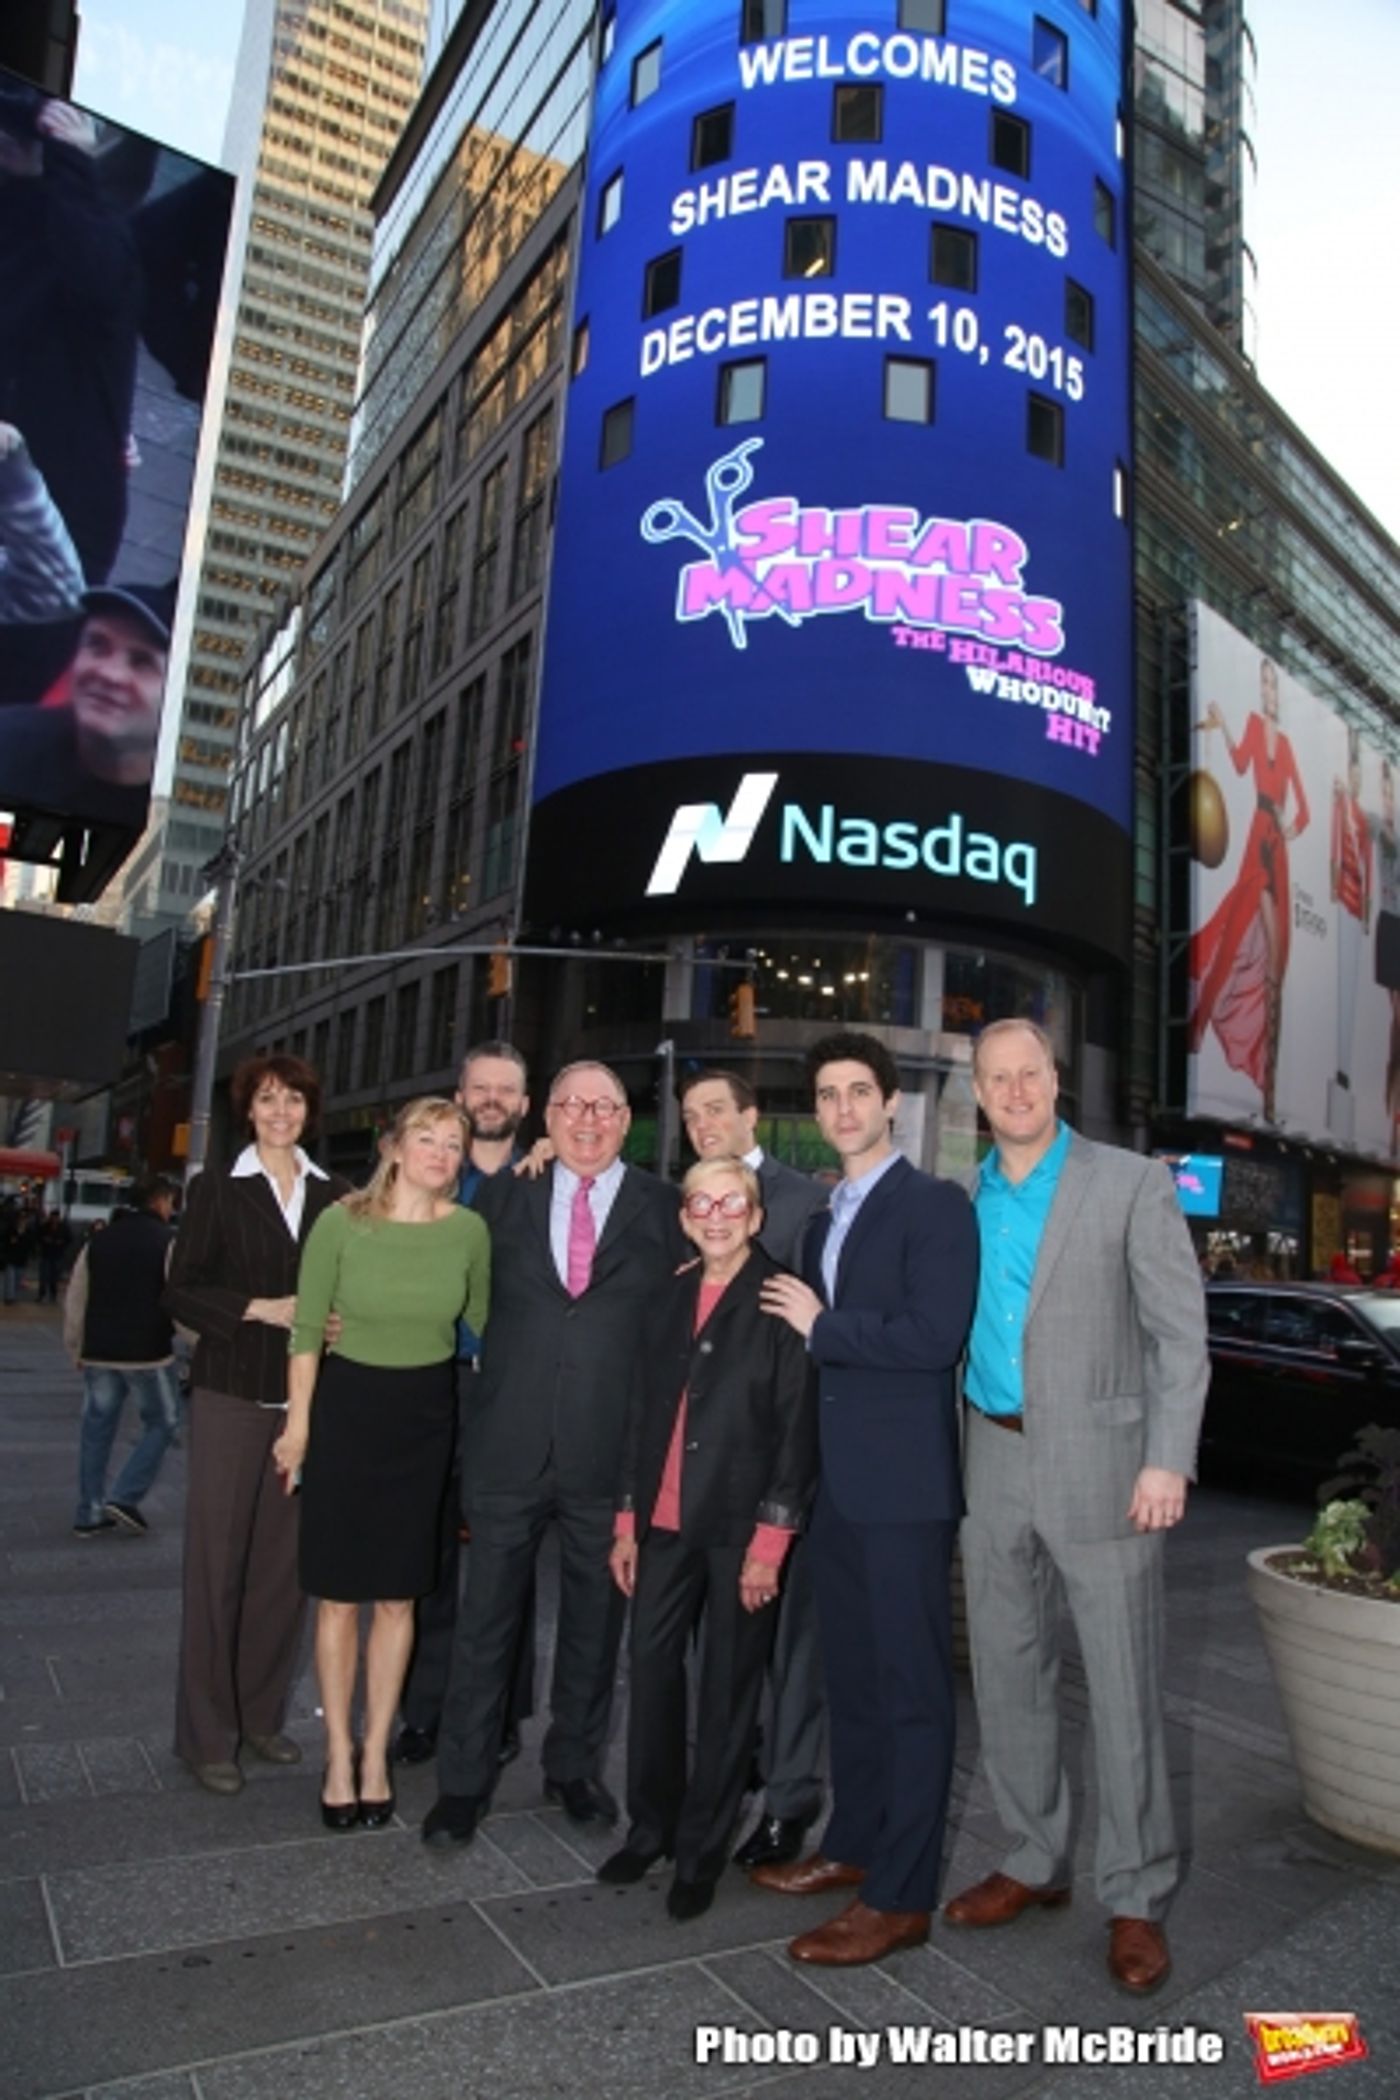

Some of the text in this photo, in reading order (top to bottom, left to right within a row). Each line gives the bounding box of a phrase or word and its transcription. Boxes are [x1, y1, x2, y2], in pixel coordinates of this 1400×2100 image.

[738, 32, 1017, 105] WELCOMES
[669, 159, 1069, 258] SHEAR MADNESS
[639, 293, 1085, 402] DECEMBER 10, 2015
[735, 499, 1025, 586] SHEAR
[680, 559, 1062, 653] MADNESS
[892, 626, 1095, 702] THE HILARIOUS
[1046, 713, 1100, 756] HIT
[779, 803, 1038, 907] Nasdaq
